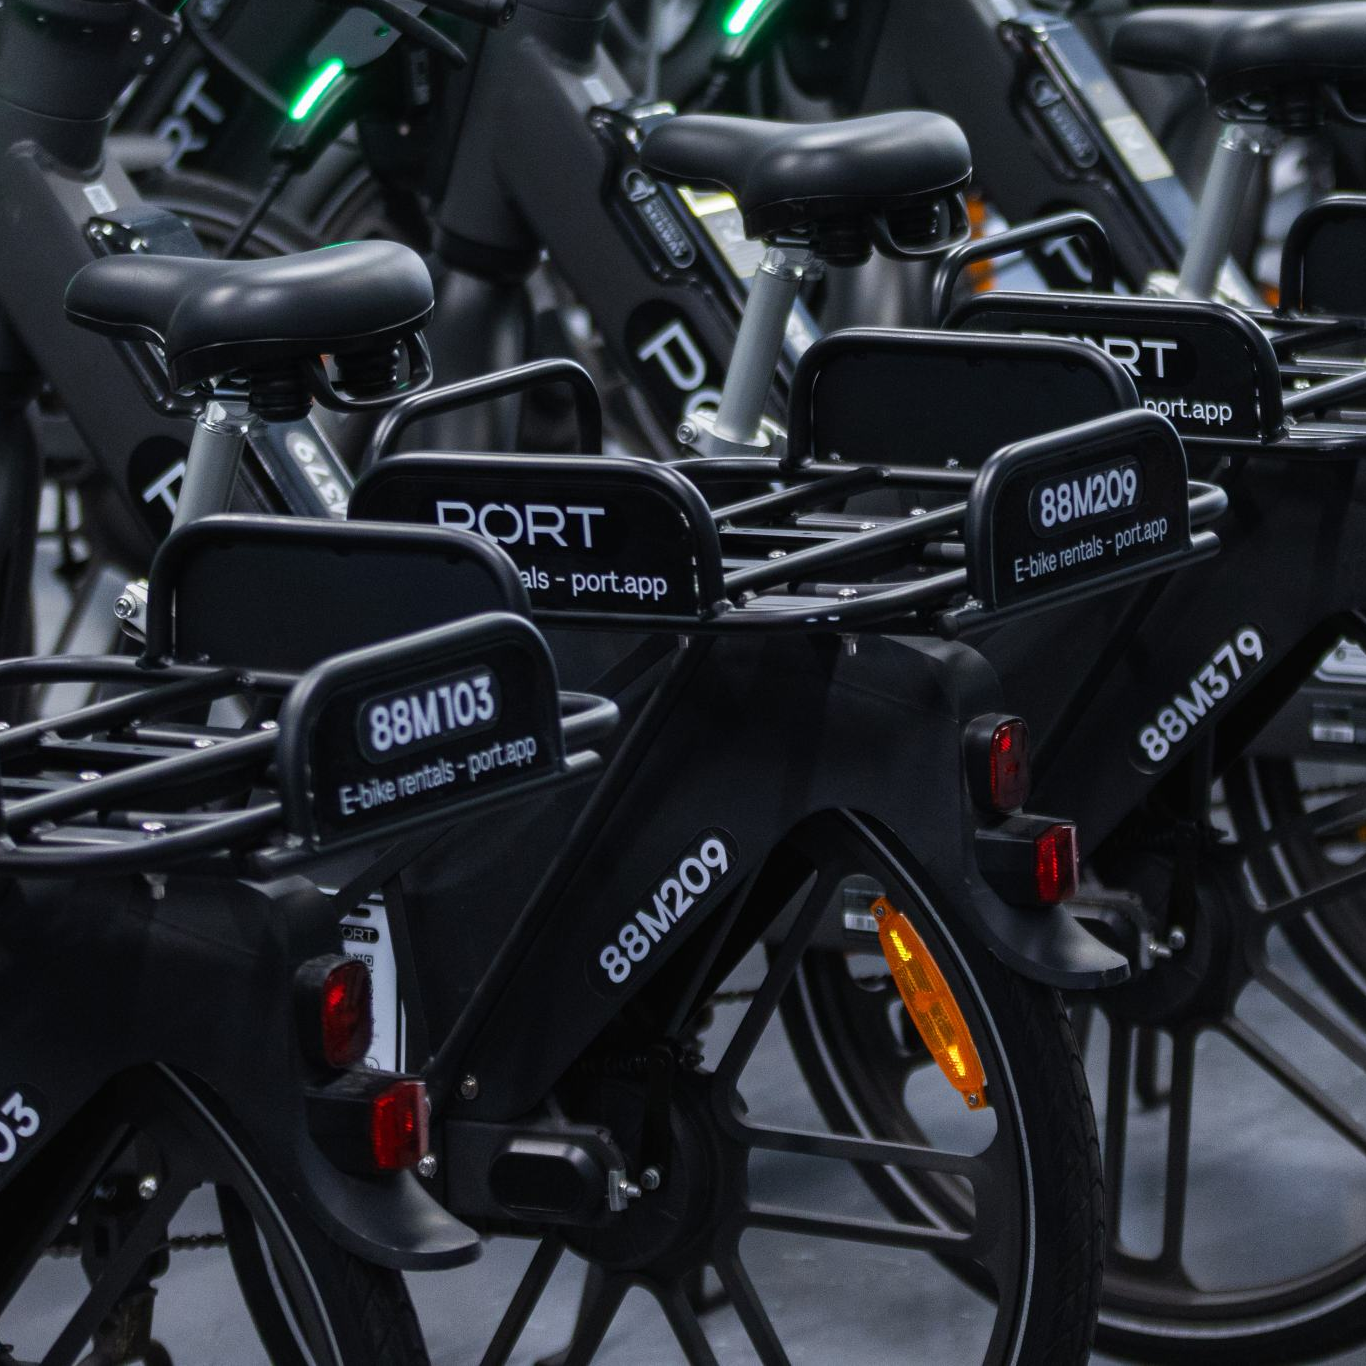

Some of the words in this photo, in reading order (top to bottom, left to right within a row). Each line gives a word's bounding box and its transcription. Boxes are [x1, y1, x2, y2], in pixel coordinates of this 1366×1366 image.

[1144, 398, 1233, 426] port.app
[436, 501, 605, 548] PORT
[1041, 468, 1137, 527] 88M209
[1014, 552, 1057, 583] E-bike
[1059, 534, 1103, 568] rentals
[1115, 518, 1168, 556] port.app
[572, 570, 668, 601] port.app
[370, 676, 494, 751] 88M103
[1140, 631, 1263, 762] 88M379
[339, 779, 396, 816] E-bike
[398, 758, 455, 797] rentals
[468, 736, 537, 782] port.app
[341, 927, 375, 942] ORT
[600, 839, 729, 983] 88M209
